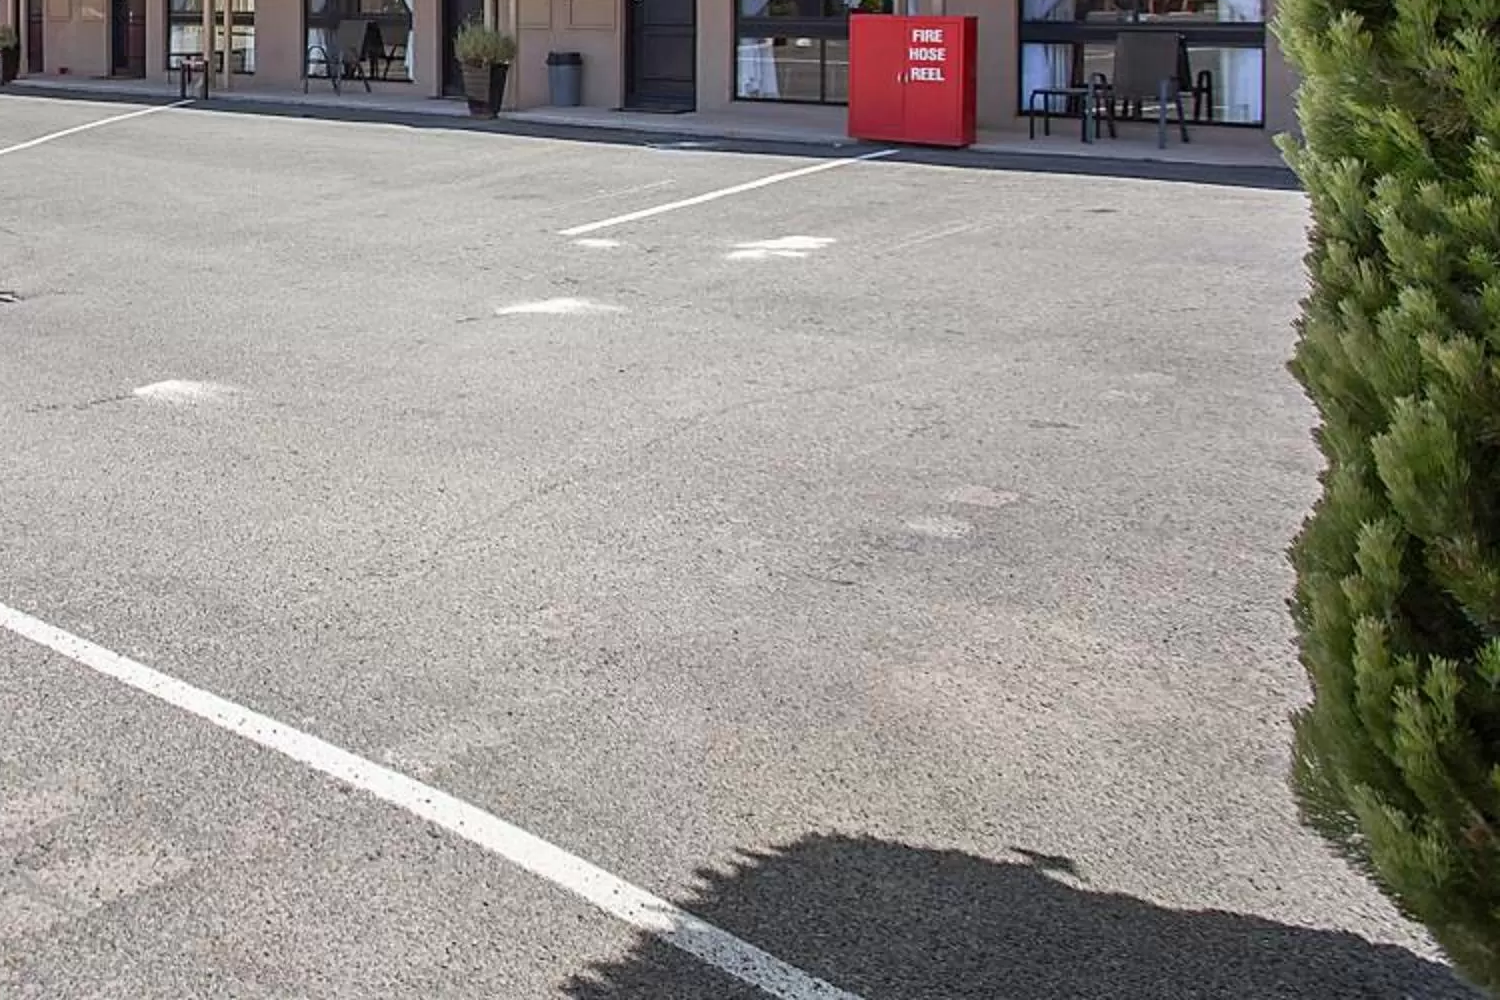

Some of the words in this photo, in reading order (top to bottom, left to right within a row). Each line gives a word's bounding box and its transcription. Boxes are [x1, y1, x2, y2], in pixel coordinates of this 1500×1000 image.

[912, 29, 944, 43] FIRE
[909, 47, 947, 61] HOSE
[910, 67, 946, 82] REEL
